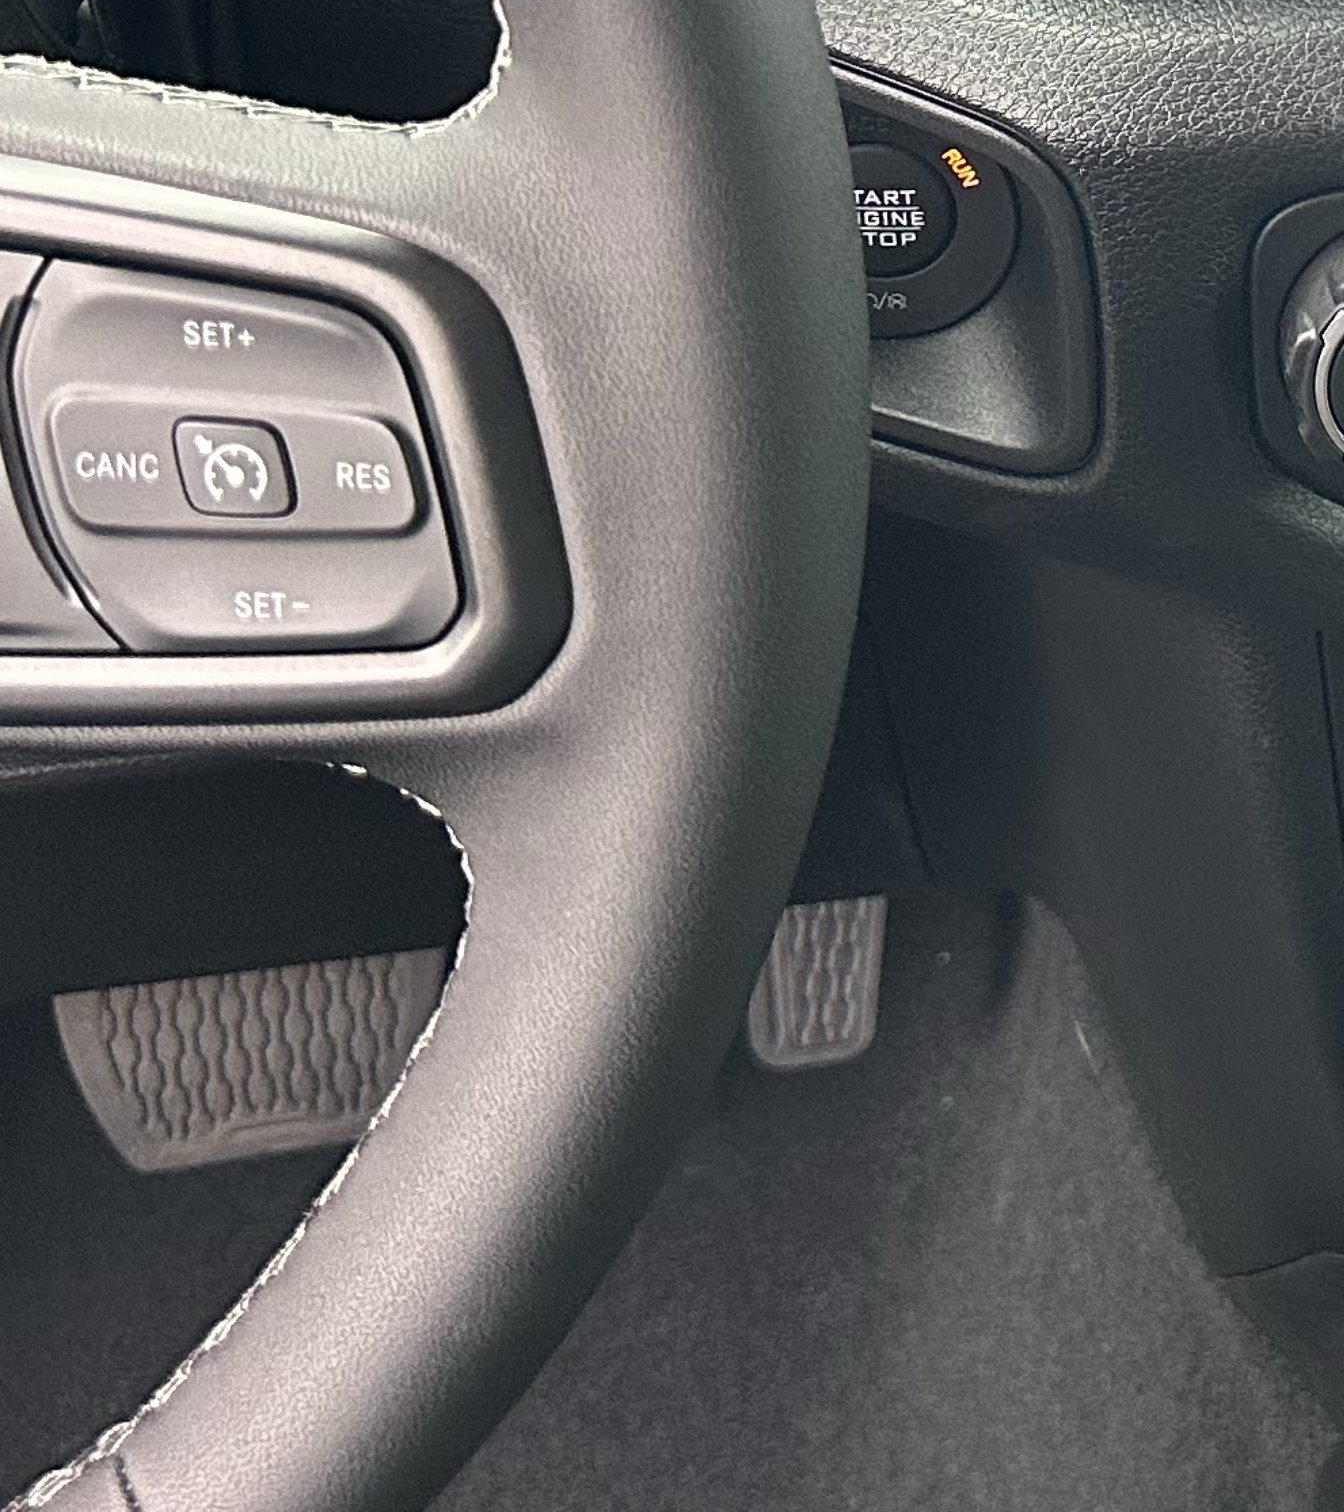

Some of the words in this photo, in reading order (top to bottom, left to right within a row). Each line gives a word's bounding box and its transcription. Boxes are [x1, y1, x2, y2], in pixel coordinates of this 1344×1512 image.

[941, 148, 981, 189] RUN
[853, 189, 917, 206] TART
[862, 231, 917, 247] TOP
[75, 451, 160, 482] CANC
[336, 462, 392, 492] RES
